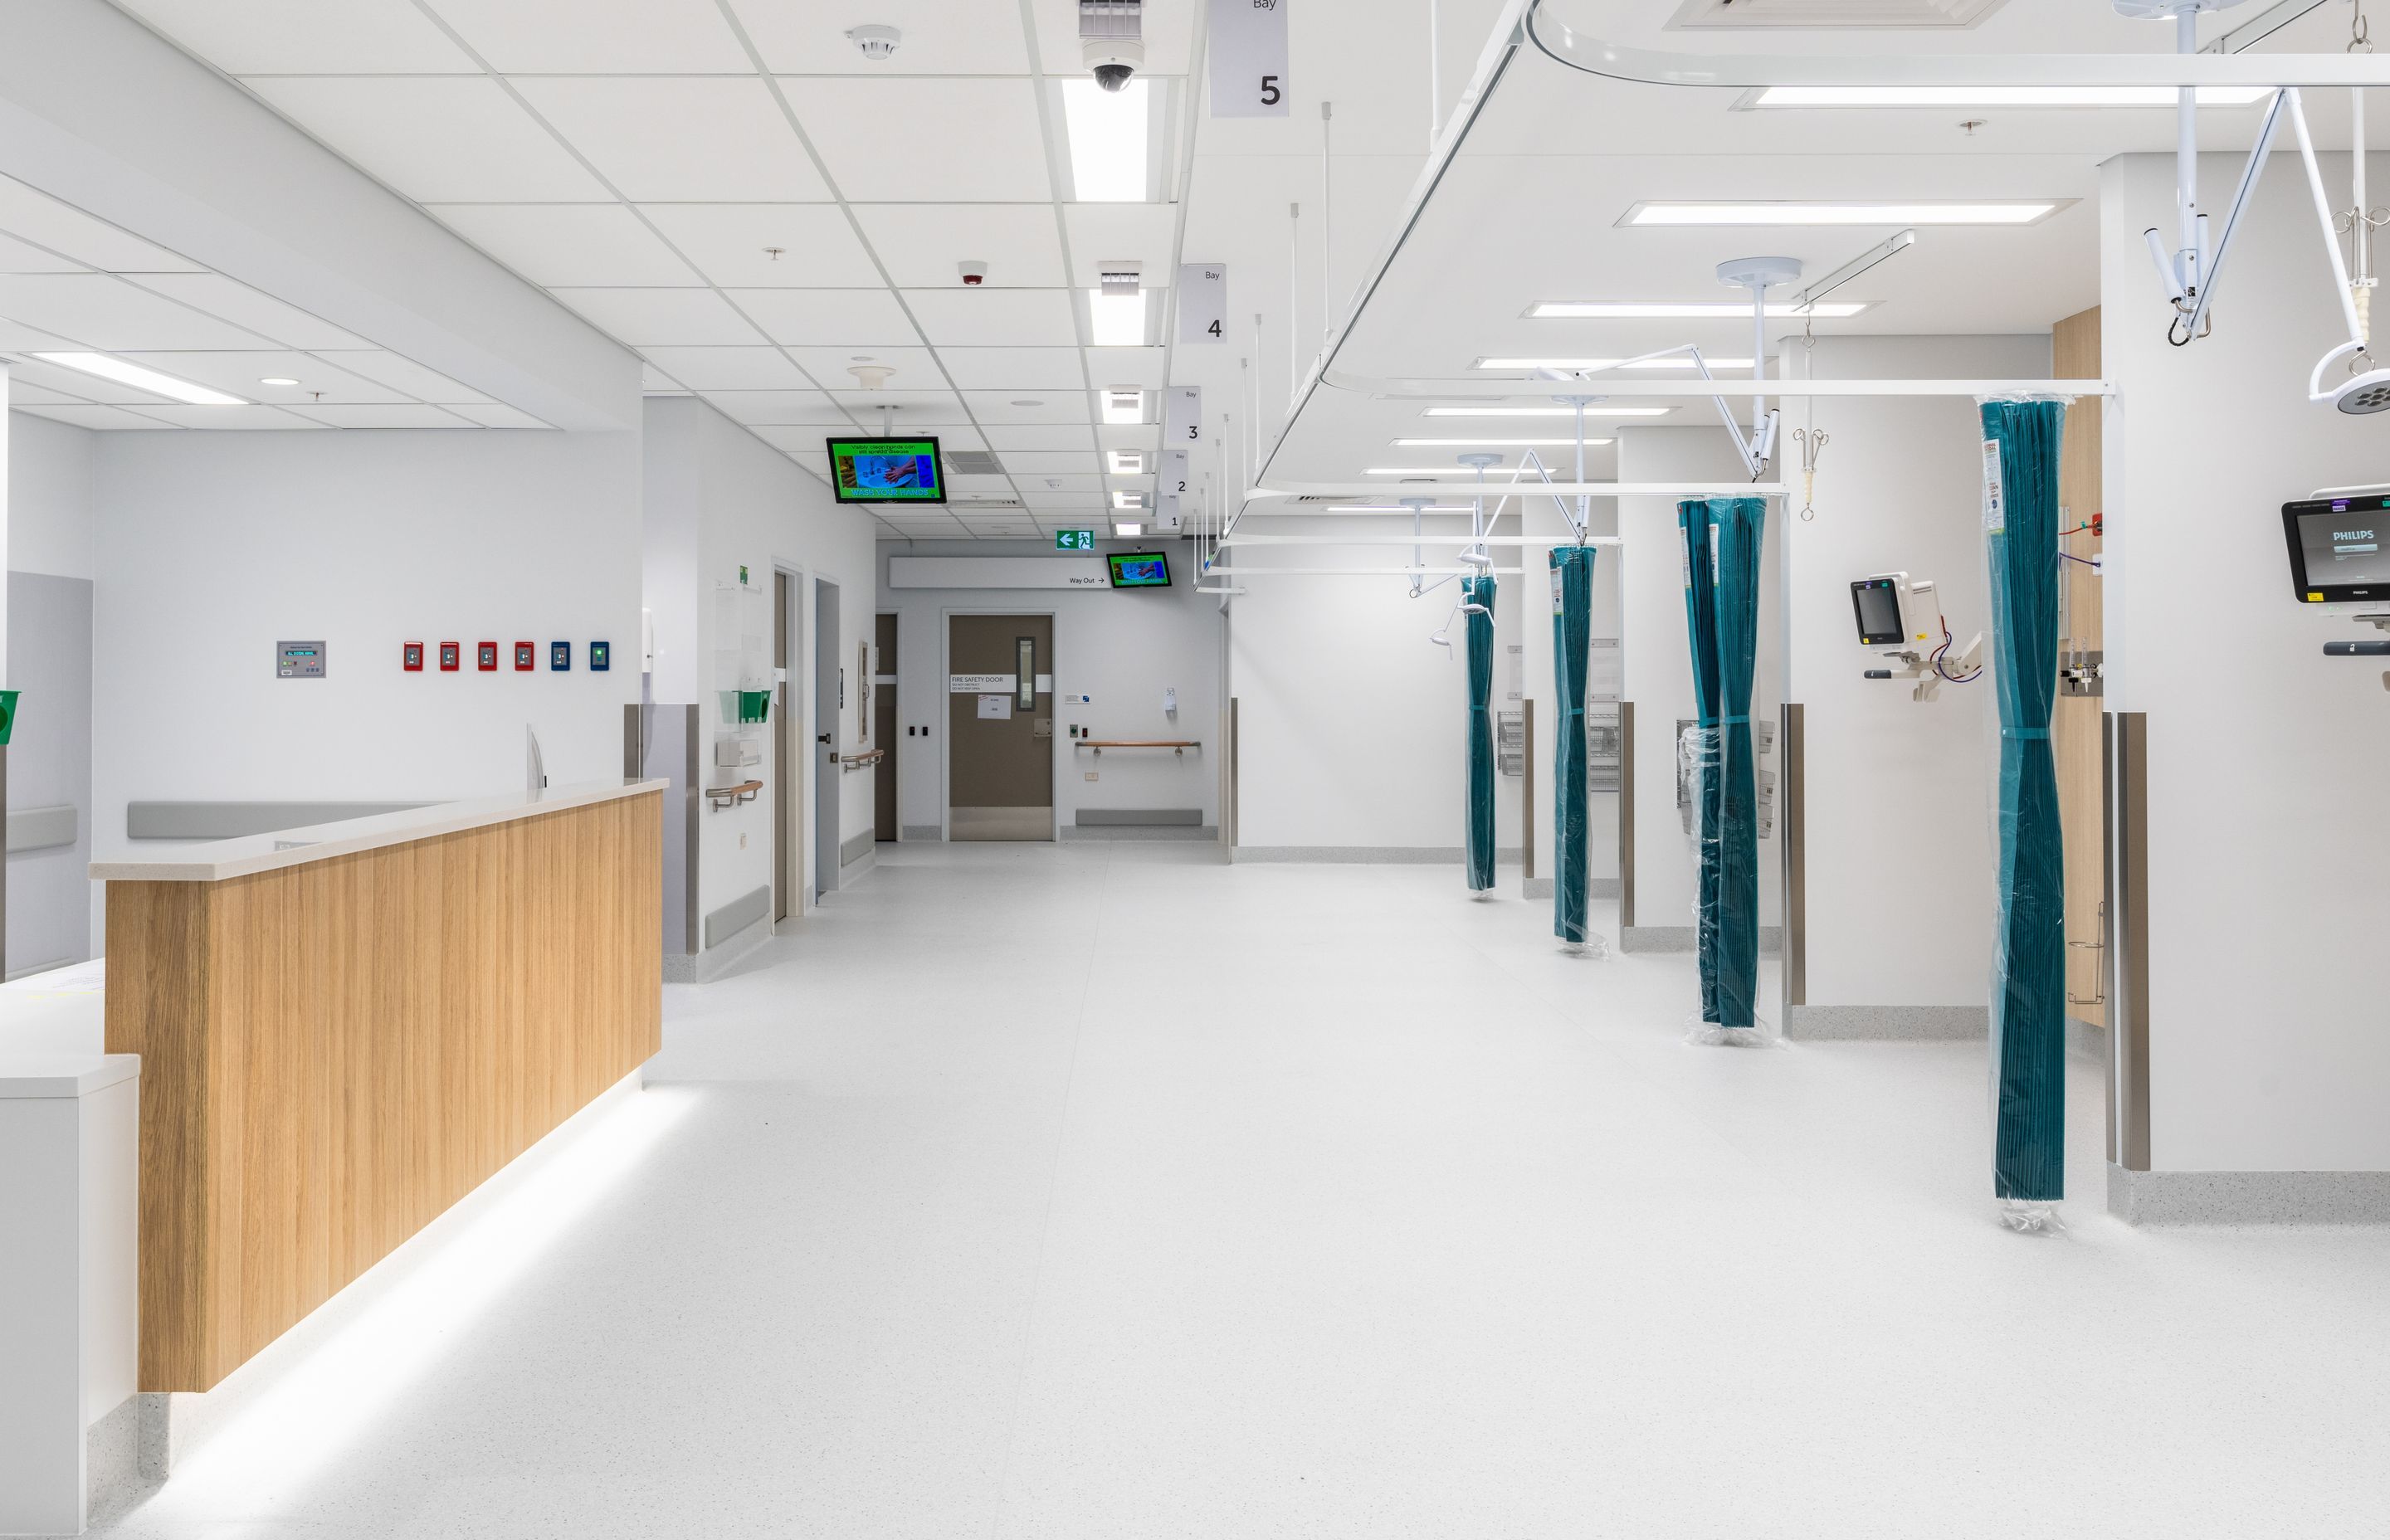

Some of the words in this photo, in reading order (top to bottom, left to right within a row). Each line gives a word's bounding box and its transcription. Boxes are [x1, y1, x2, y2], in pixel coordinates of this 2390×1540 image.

[1253, 0, 1276, 11] Bay
[1261, 76, 1280, 105] 5
[1206, 271, 1220, 280] Bay
[1208, 319, 1222, 338] 4
[1188, 426, 1198, 439] 3
[1178, 481, 1186, 491] 2
[1172, 517, 1178, 526] 1
[2333, 530, 2374, 541] PHILIPS
